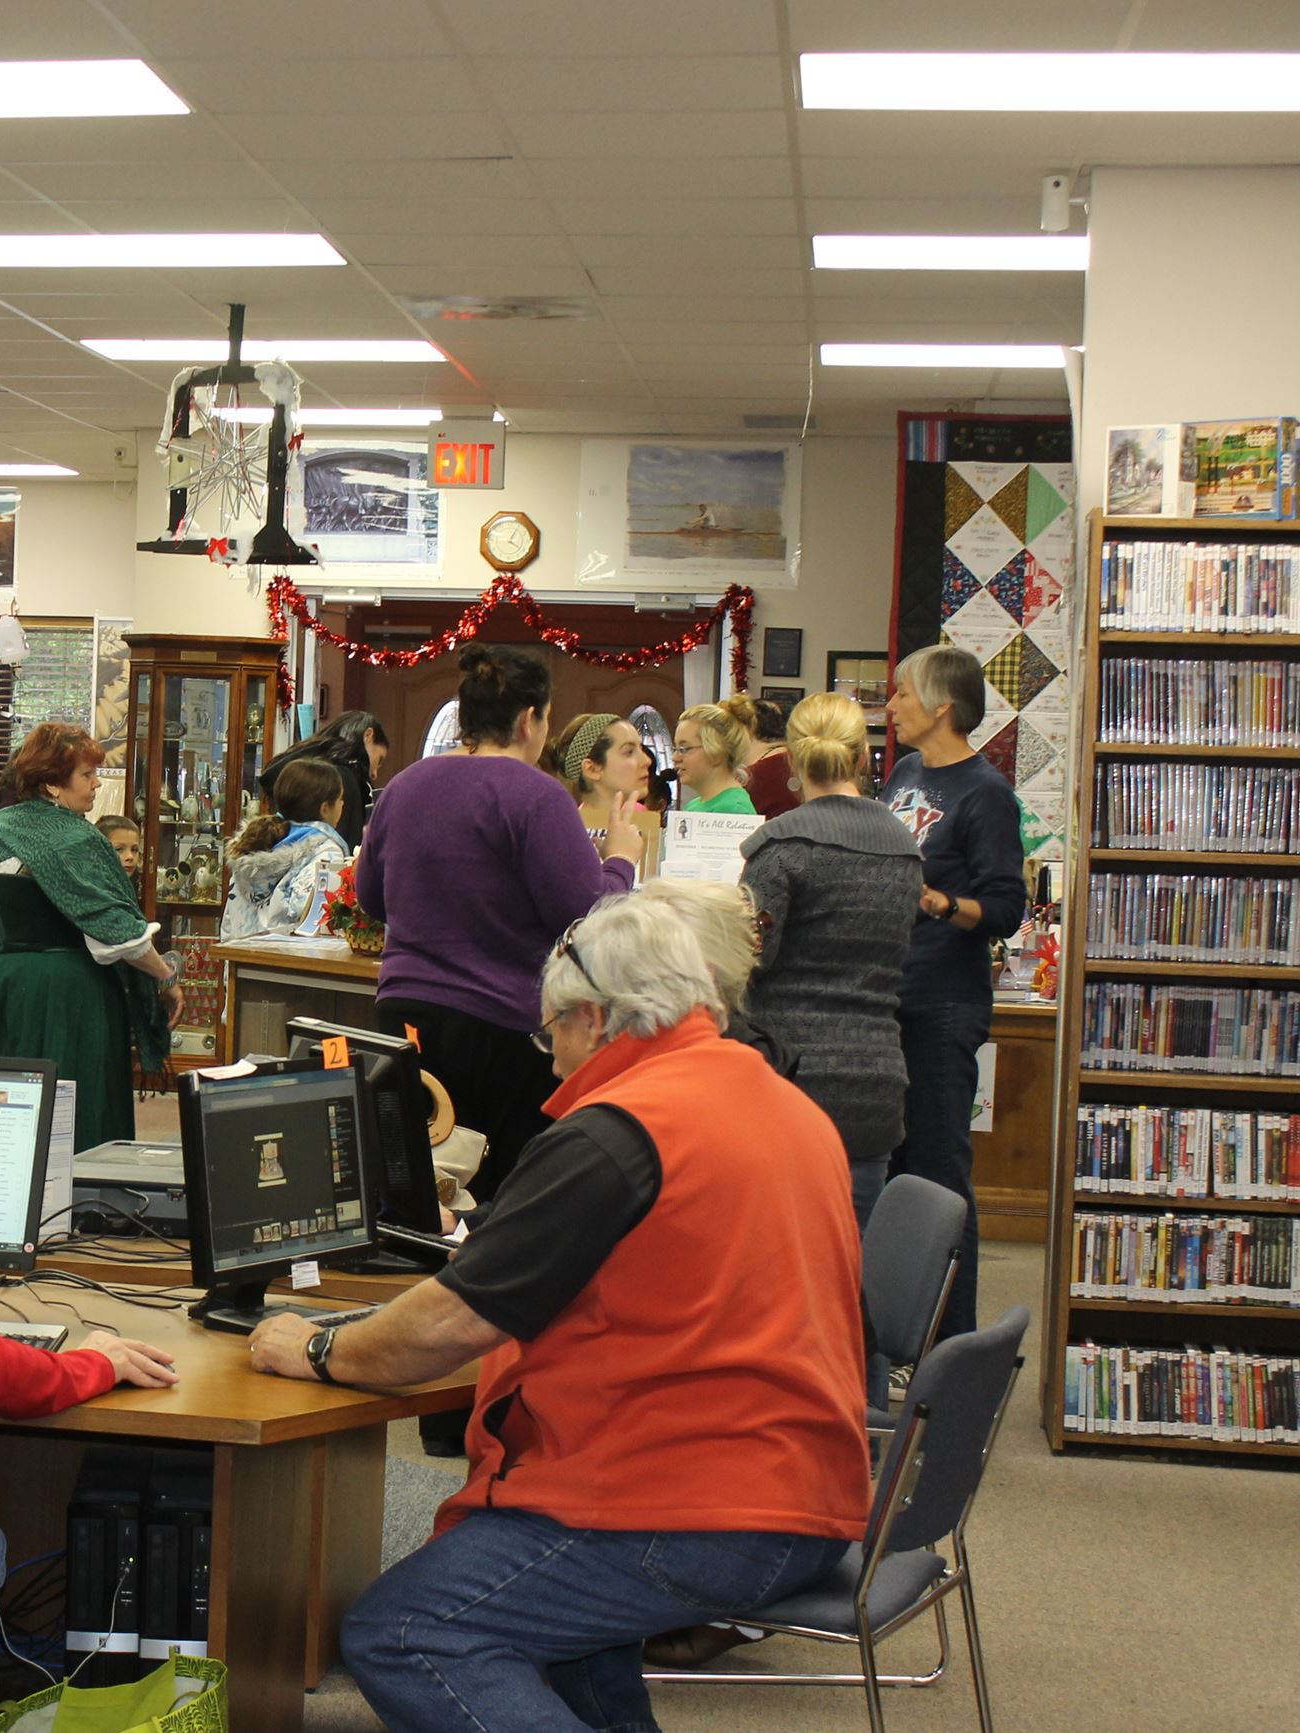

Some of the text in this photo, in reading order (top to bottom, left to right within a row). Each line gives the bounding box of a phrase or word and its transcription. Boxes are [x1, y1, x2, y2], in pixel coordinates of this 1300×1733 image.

[435, 443, 495, 485] EXIT
[697, 819, 710, 828] It's
[712, 820, 724, 829] All
[329, 1041, 342, 1066] 2
